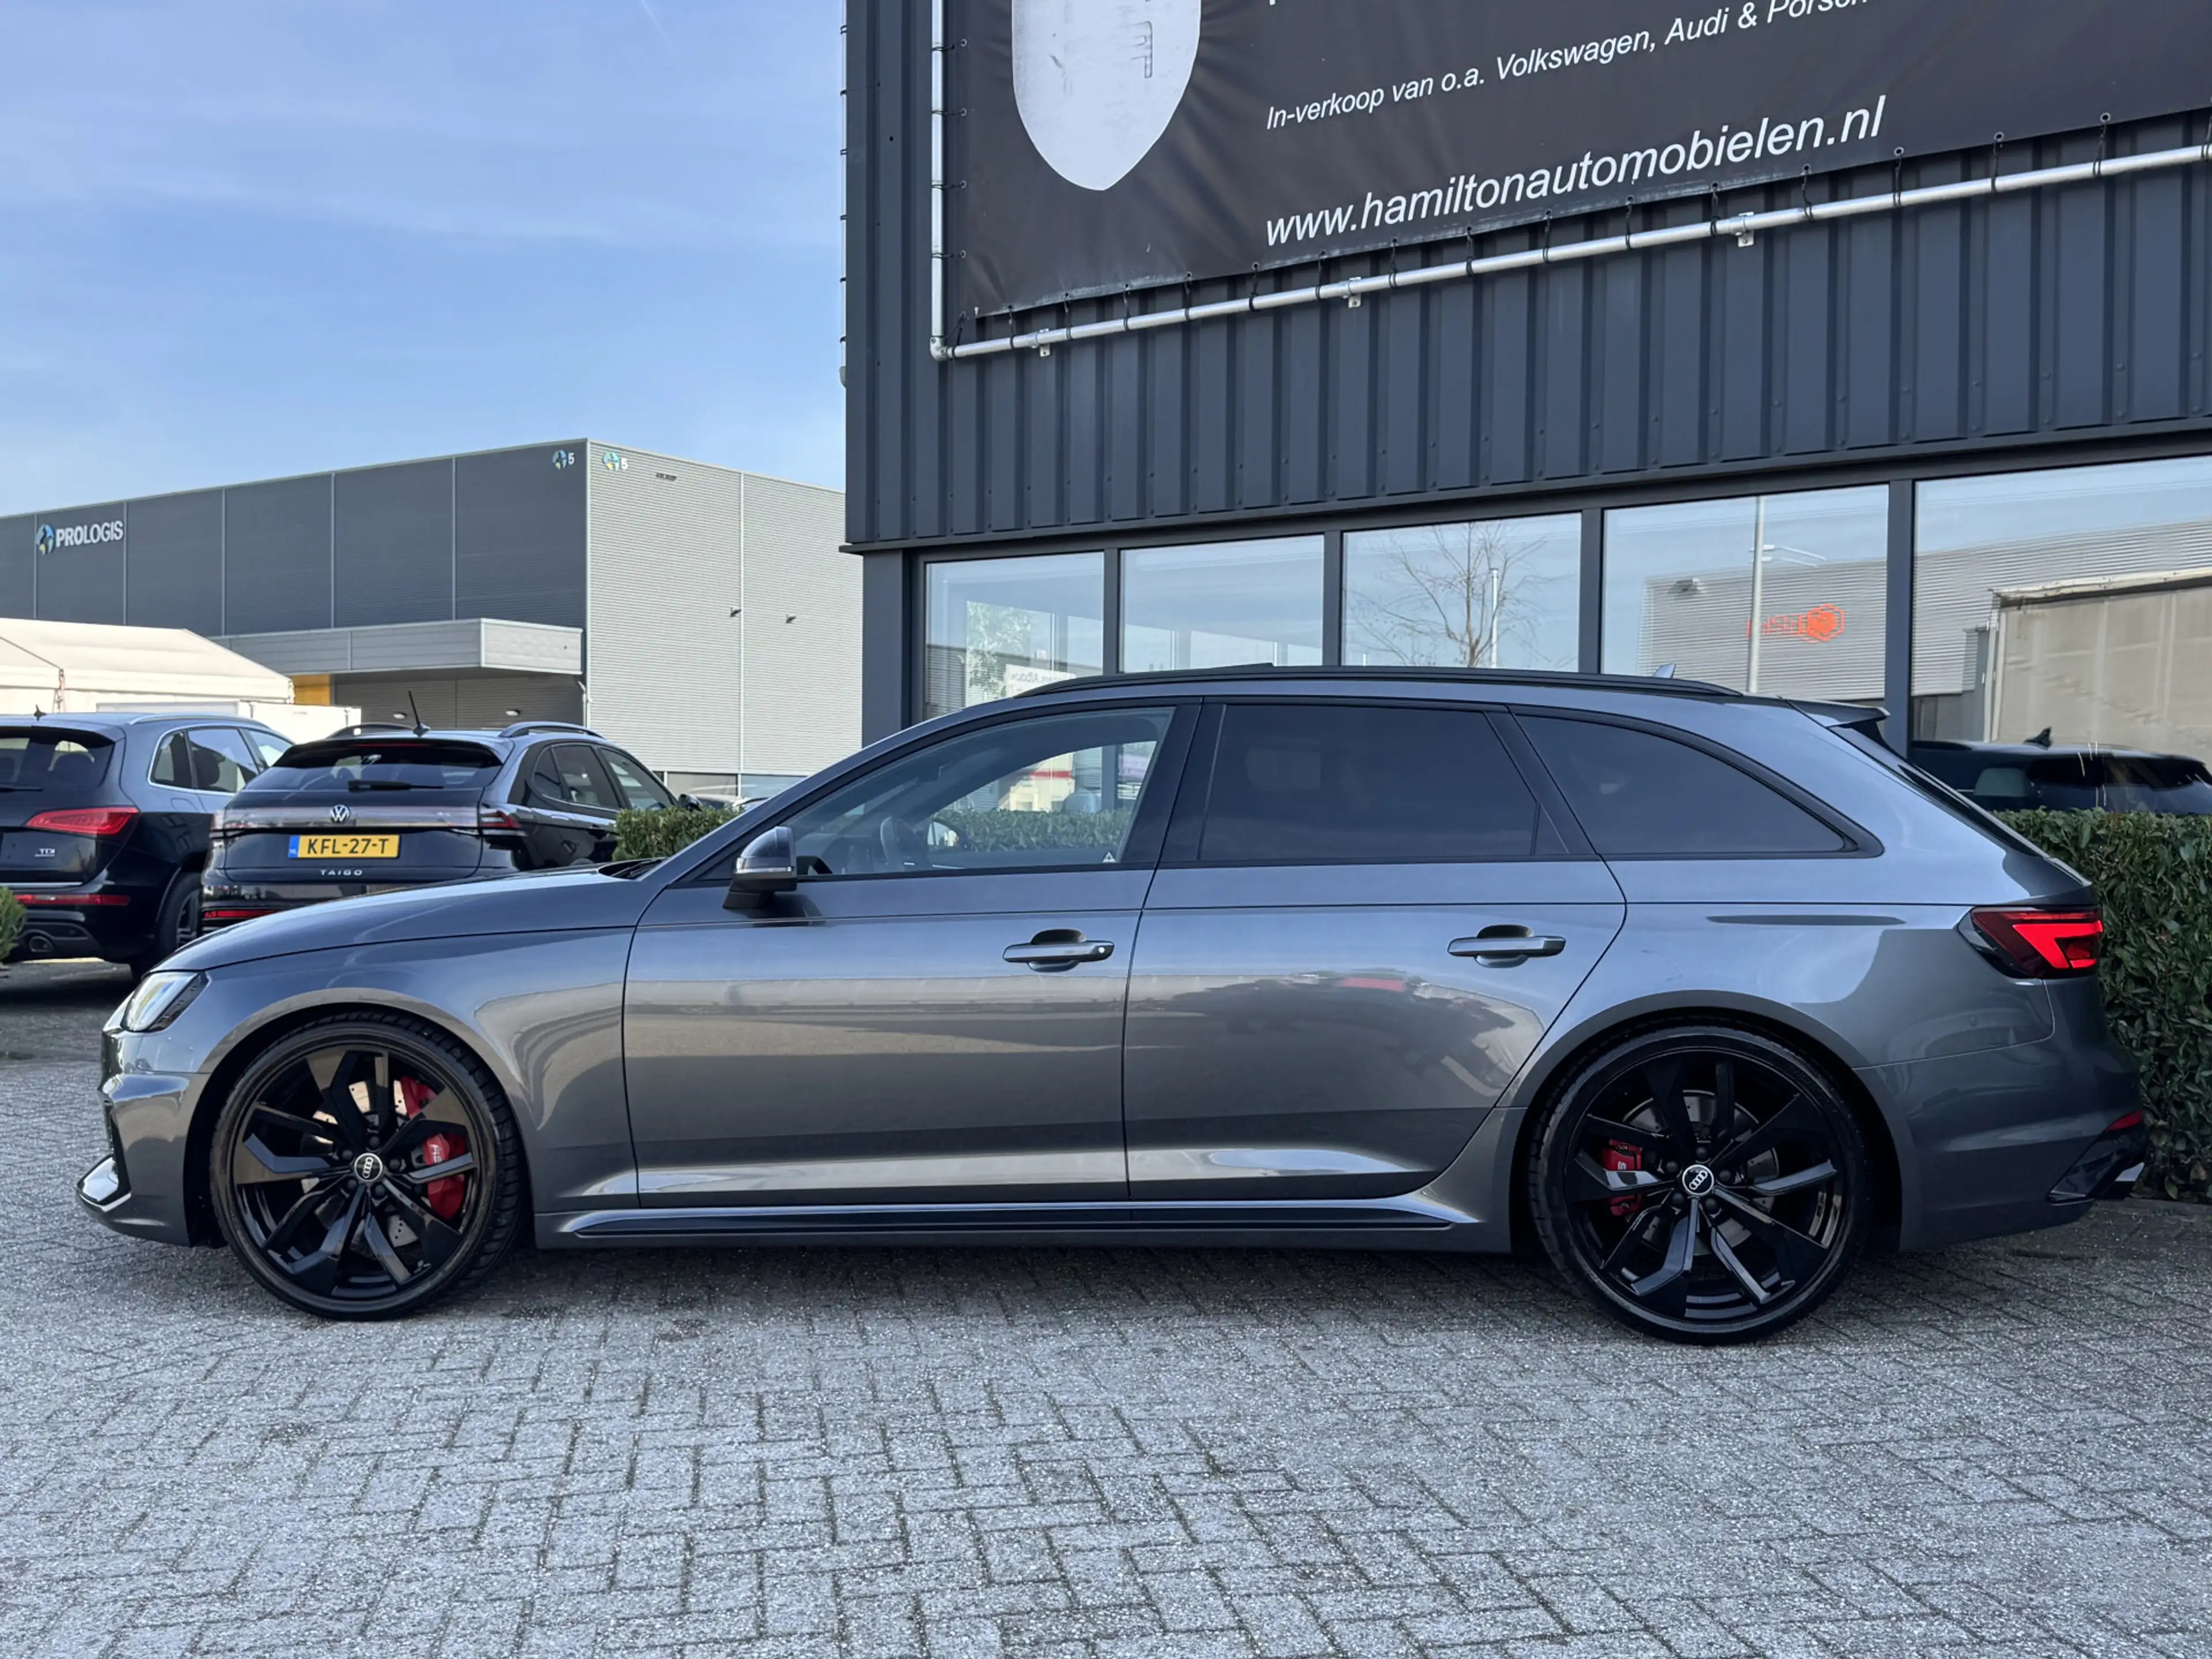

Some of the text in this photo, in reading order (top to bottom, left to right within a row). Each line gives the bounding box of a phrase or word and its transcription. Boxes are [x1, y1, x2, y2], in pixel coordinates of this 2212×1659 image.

[1267, 0, 1867, 130] In-verkoop van o.a. Volkswagen, Audi & Pors
[1267, 94, 1886, 246] www.hamiltonautomobielen.nl
[568, 453, 575, 465] 5
[56, 520, 124, 548] PROLOGIS
[307, 838, 389, 855] KFL-27-T
